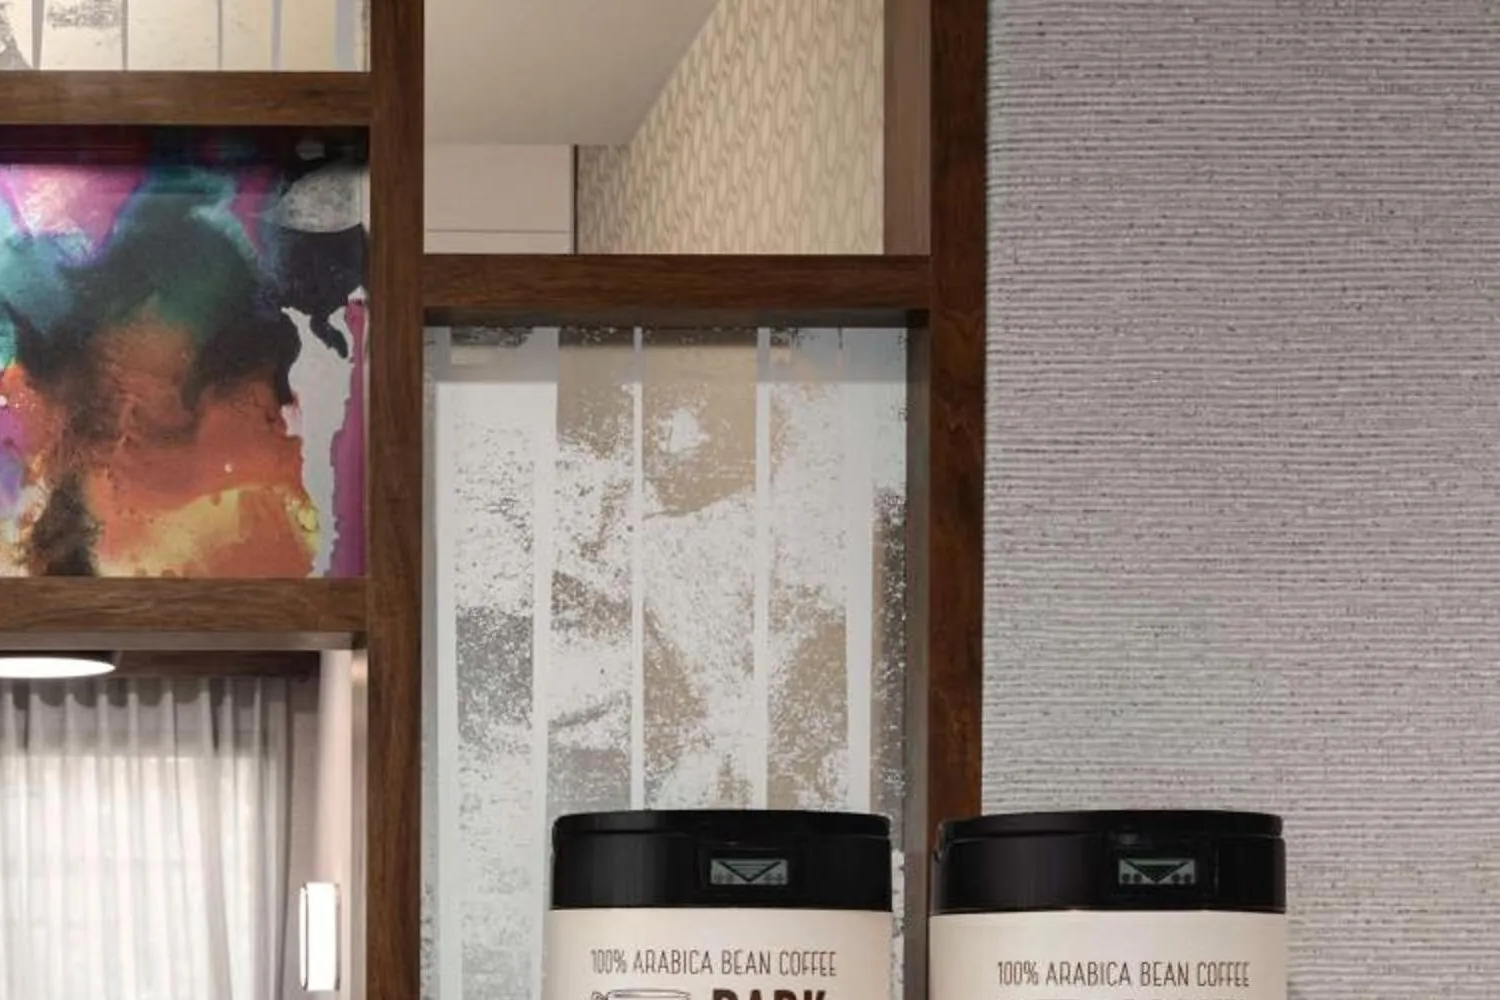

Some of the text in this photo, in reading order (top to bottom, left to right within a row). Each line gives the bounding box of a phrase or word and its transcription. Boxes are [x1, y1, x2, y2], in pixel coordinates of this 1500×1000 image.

[591, 950, 837, 976] 100% ARABICA BEAN COFFEE
[998, 961, 1250, 988] 100% ARABICA BEAN COFFEE
